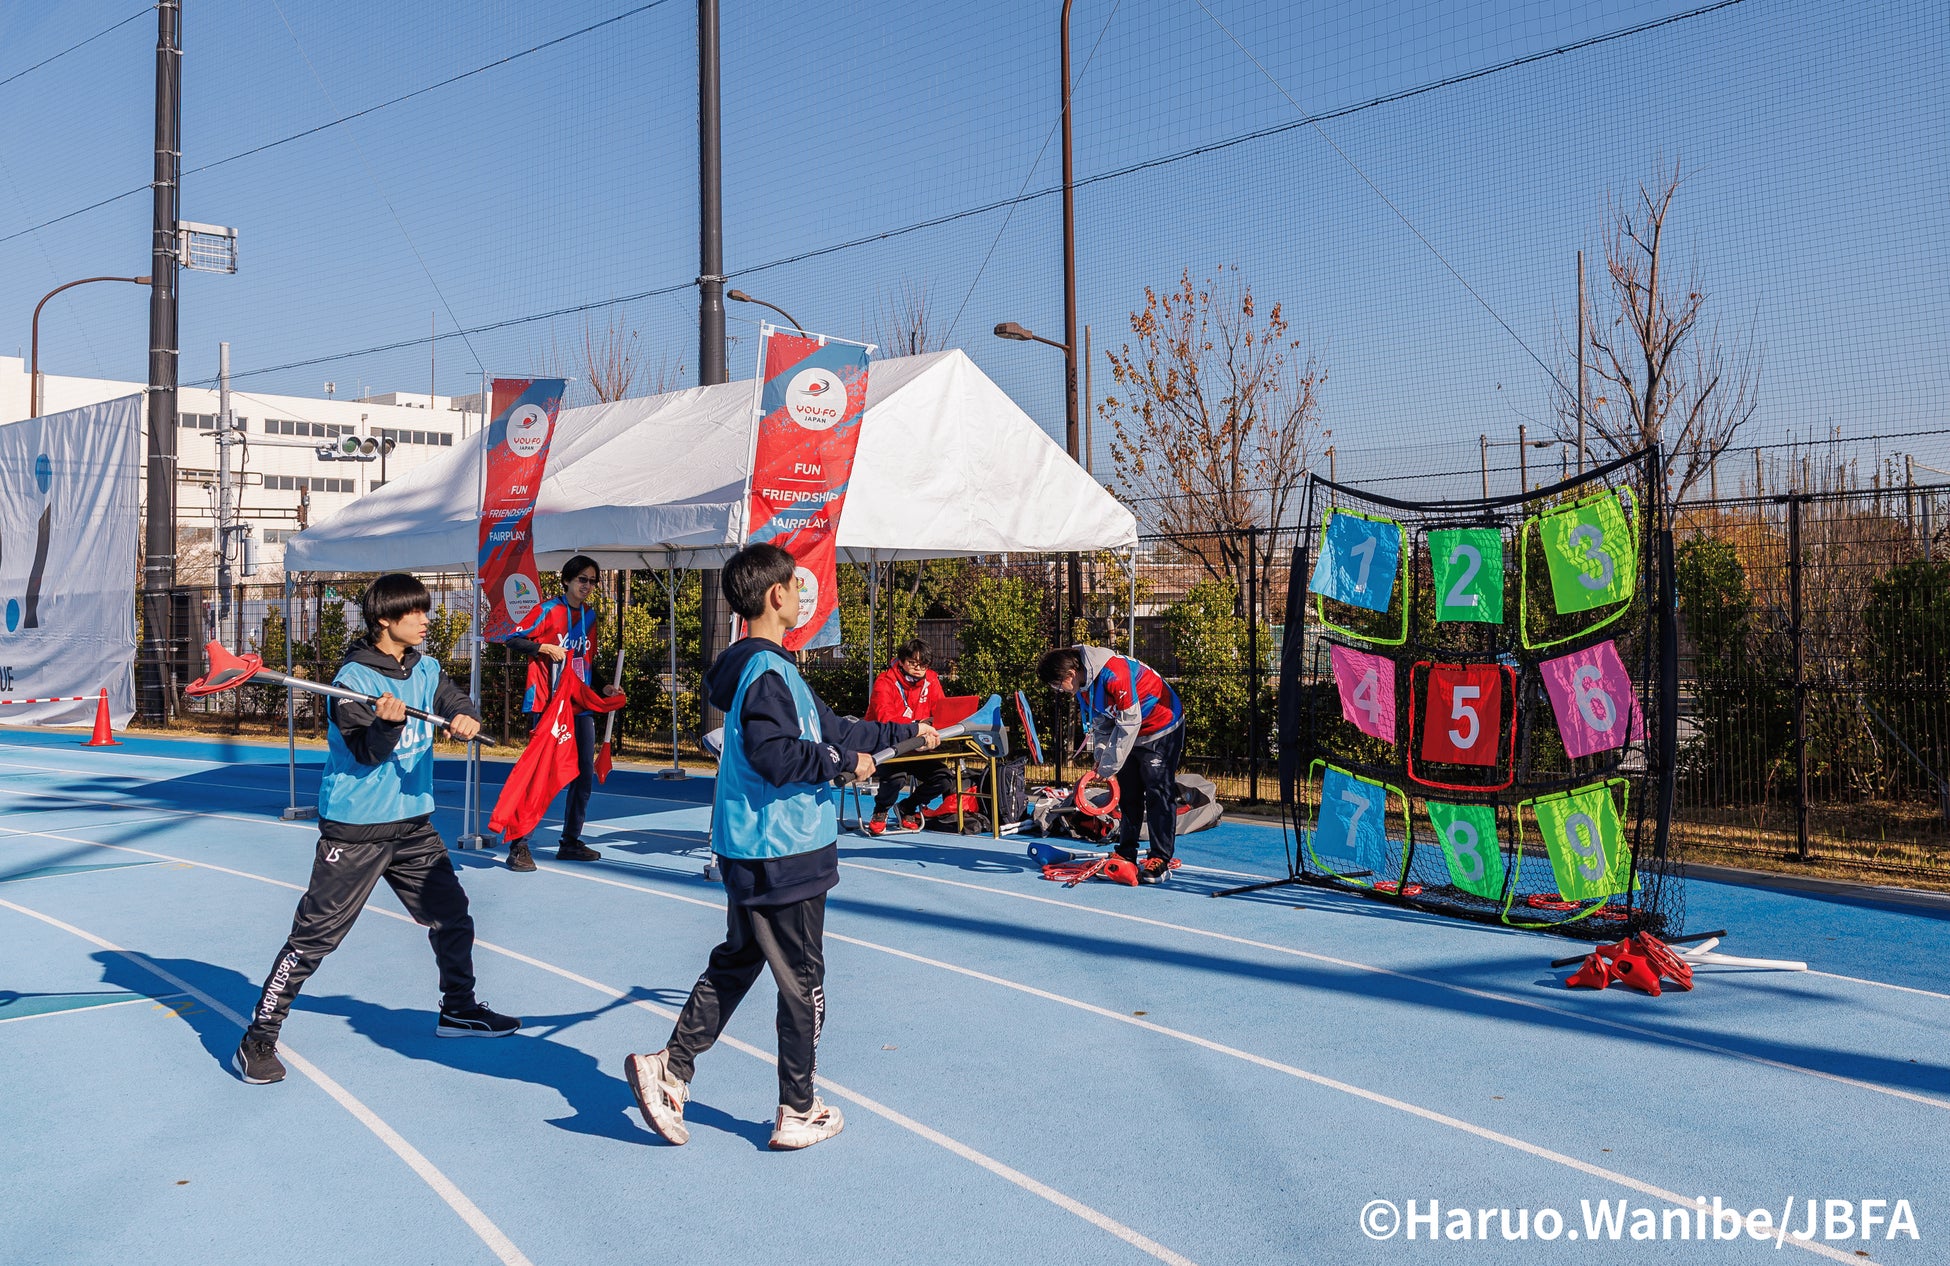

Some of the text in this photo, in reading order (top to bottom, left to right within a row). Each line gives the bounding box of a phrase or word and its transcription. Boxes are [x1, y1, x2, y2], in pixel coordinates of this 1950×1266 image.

[804, 416, 827, 424] JAPAN
[511, 485, 528, 495] FUN
[762, 489, 838, 502] FRIENDSHIP
[794, 463, 821, 475] FUN
[489, 506, 532, 518] FRIENDSHIP
[489, 531, 525, 541] FAIRPLAY
[1350, 537, 1377, 592] 1
[1444, 545, 1482, 606] 2
[1569, 524, 1613, 590] 3
[1353, 669, 1380, 723] 4
[1448, 686, 1480, 749] 5
[1572, 665, 1616, 731] 6
[1341, 790, 1370, 847] 7
[1446, 820, 1484, 881] 8
[1565, 813, 1606, 882] 9
